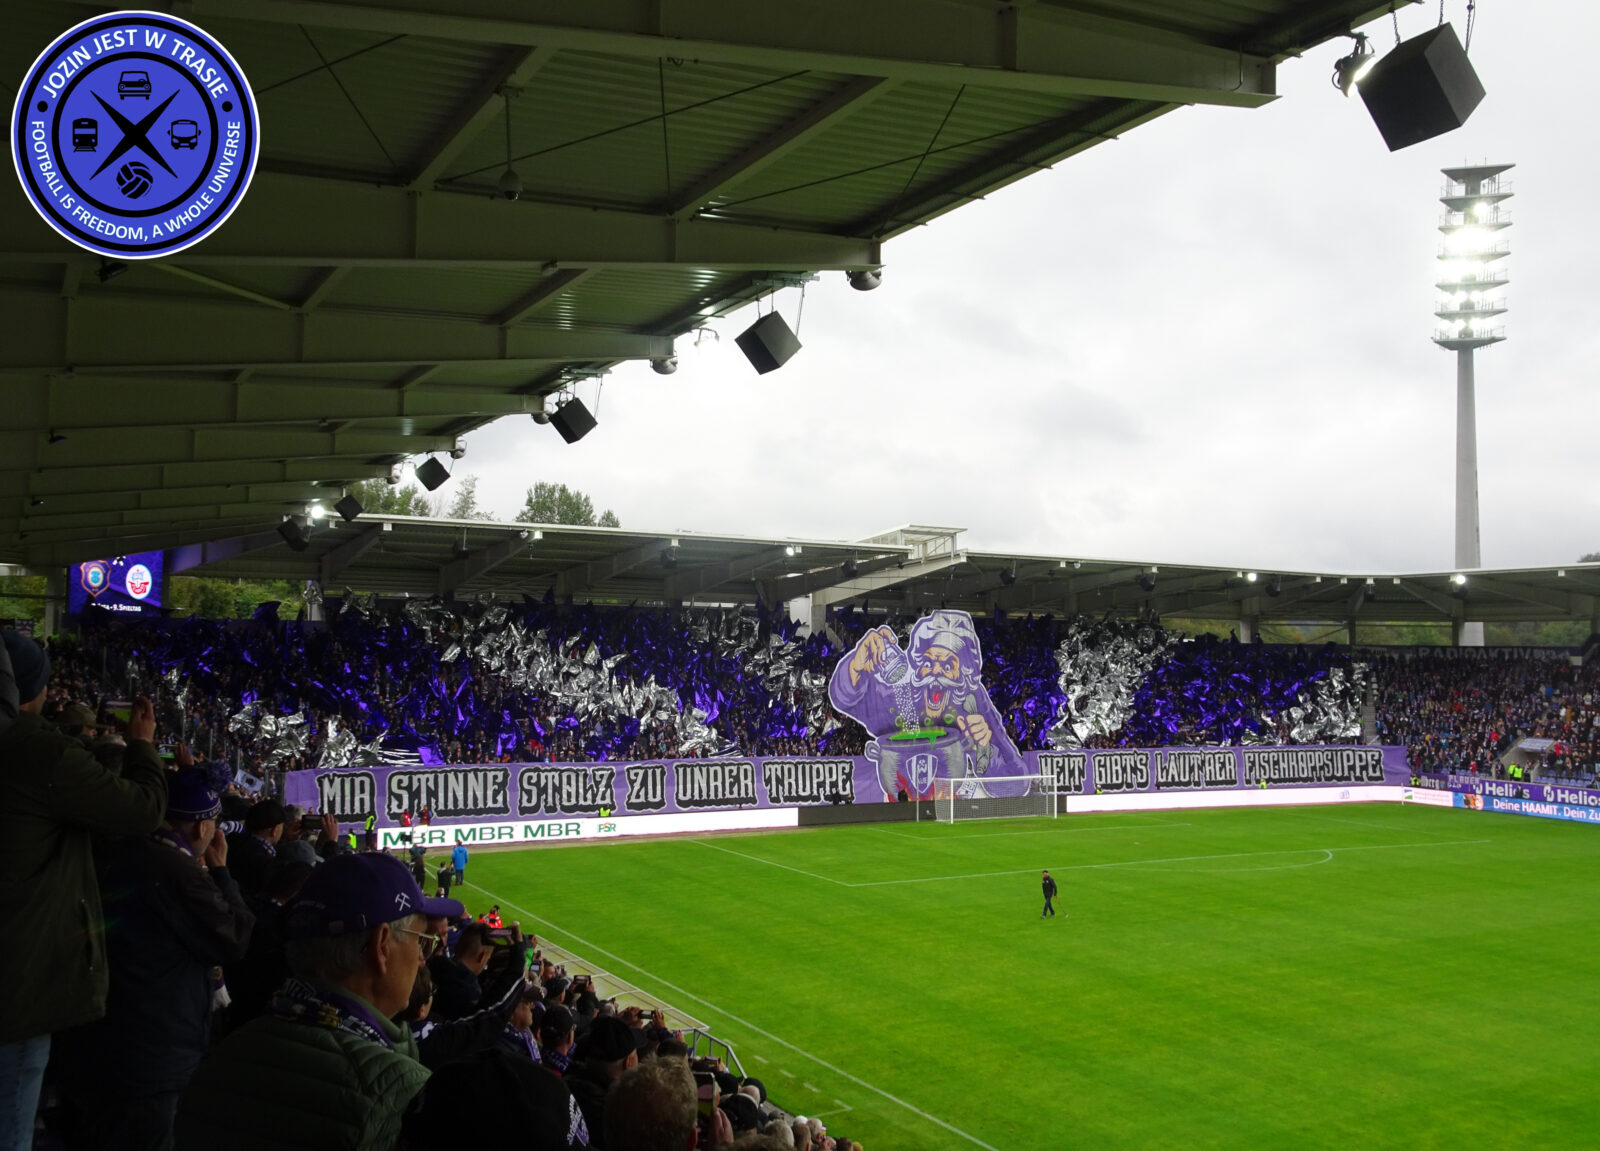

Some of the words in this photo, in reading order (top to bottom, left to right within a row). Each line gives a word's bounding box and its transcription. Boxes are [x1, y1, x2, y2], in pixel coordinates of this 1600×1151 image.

[520, 769, 614, 810] STOLZ
[627, 767, 665, 806] ZU
[763, 761, 853, 801] TRUPPE
[1485, 782, 1530, 799] Helis
[1557, 789, 1600, 806] Helio
[1493, 798, 1520, 811] Deine
[1521, 801, 1561, 816] HAAMIT.
[1563, 806, 1586, 819] Dein
[454, 826, 514, 843] MBR
[523, 822, 581, 838] MBR
